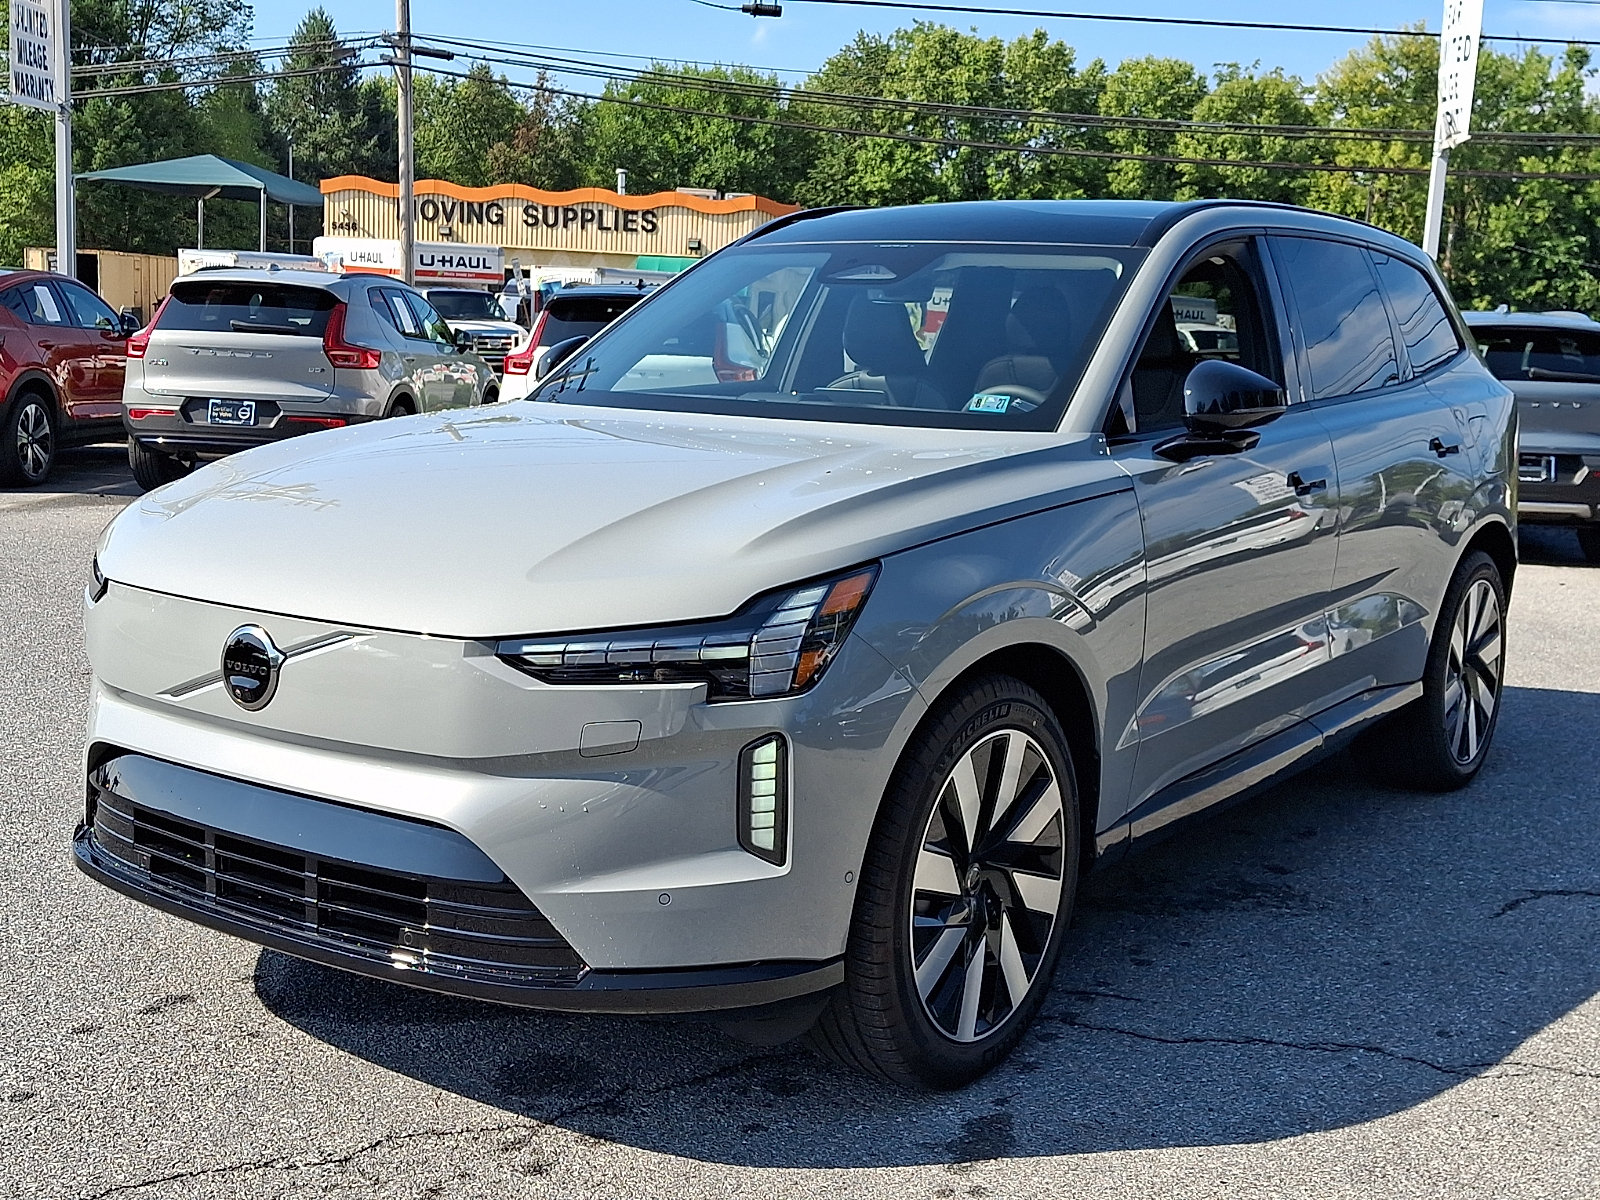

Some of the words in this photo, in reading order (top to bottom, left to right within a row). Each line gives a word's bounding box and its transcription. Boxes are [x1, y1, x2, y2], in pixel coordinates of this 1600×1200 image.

[16, 37, 49, 71] MILEAGE
[396, 198, 504, 226] OVING
[522, 204, 658, 233] SUPPLIES
[350, 251, 384, 264] U-HAUL
[419, 253, 493, 270] U-HAUL
[995, 398, 1008, 410] 27
[226, 659, 268, 676] VOLVO
